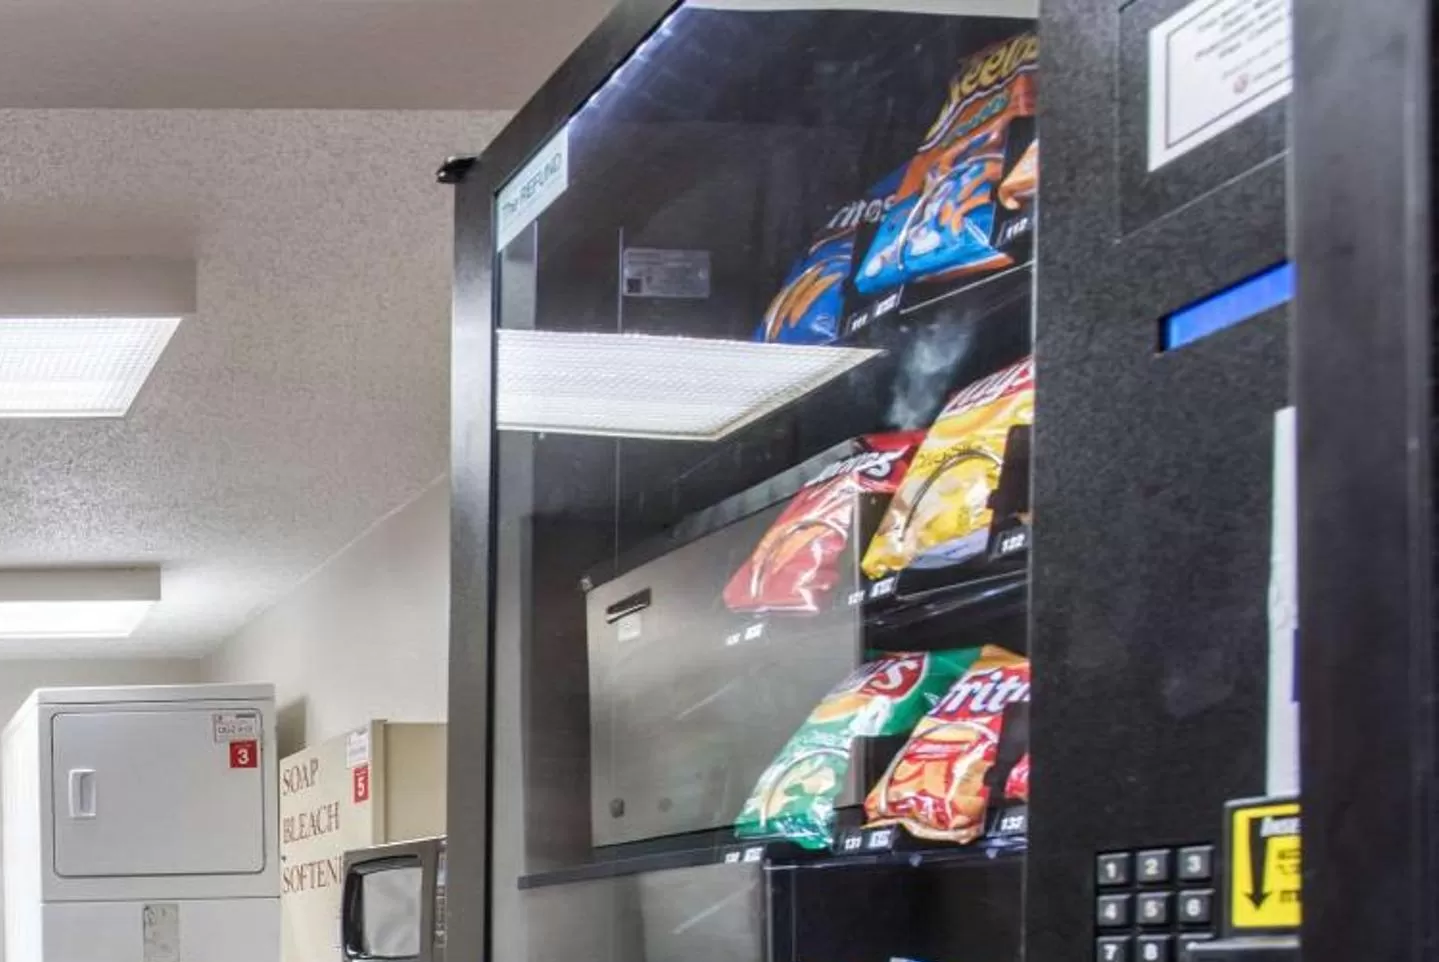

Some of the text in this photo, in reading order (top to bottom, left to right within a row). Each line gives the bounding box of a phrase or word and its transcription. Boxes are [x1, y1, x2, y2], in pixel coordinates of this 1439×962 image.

[928, 670, 1030, 715] Frit
[236, 748, 249, 765] 3
[283, 758, 319, 796] SOAP
[283, 801, 340, 843] BLEACH
[283, 855, 342, 893] SOFTEN
[1106, 855, 1202, 878] 1 2 3
[1104, 898, 1200, 920] 4 5 6
[1104, 944, 1158, 960] 7 8
